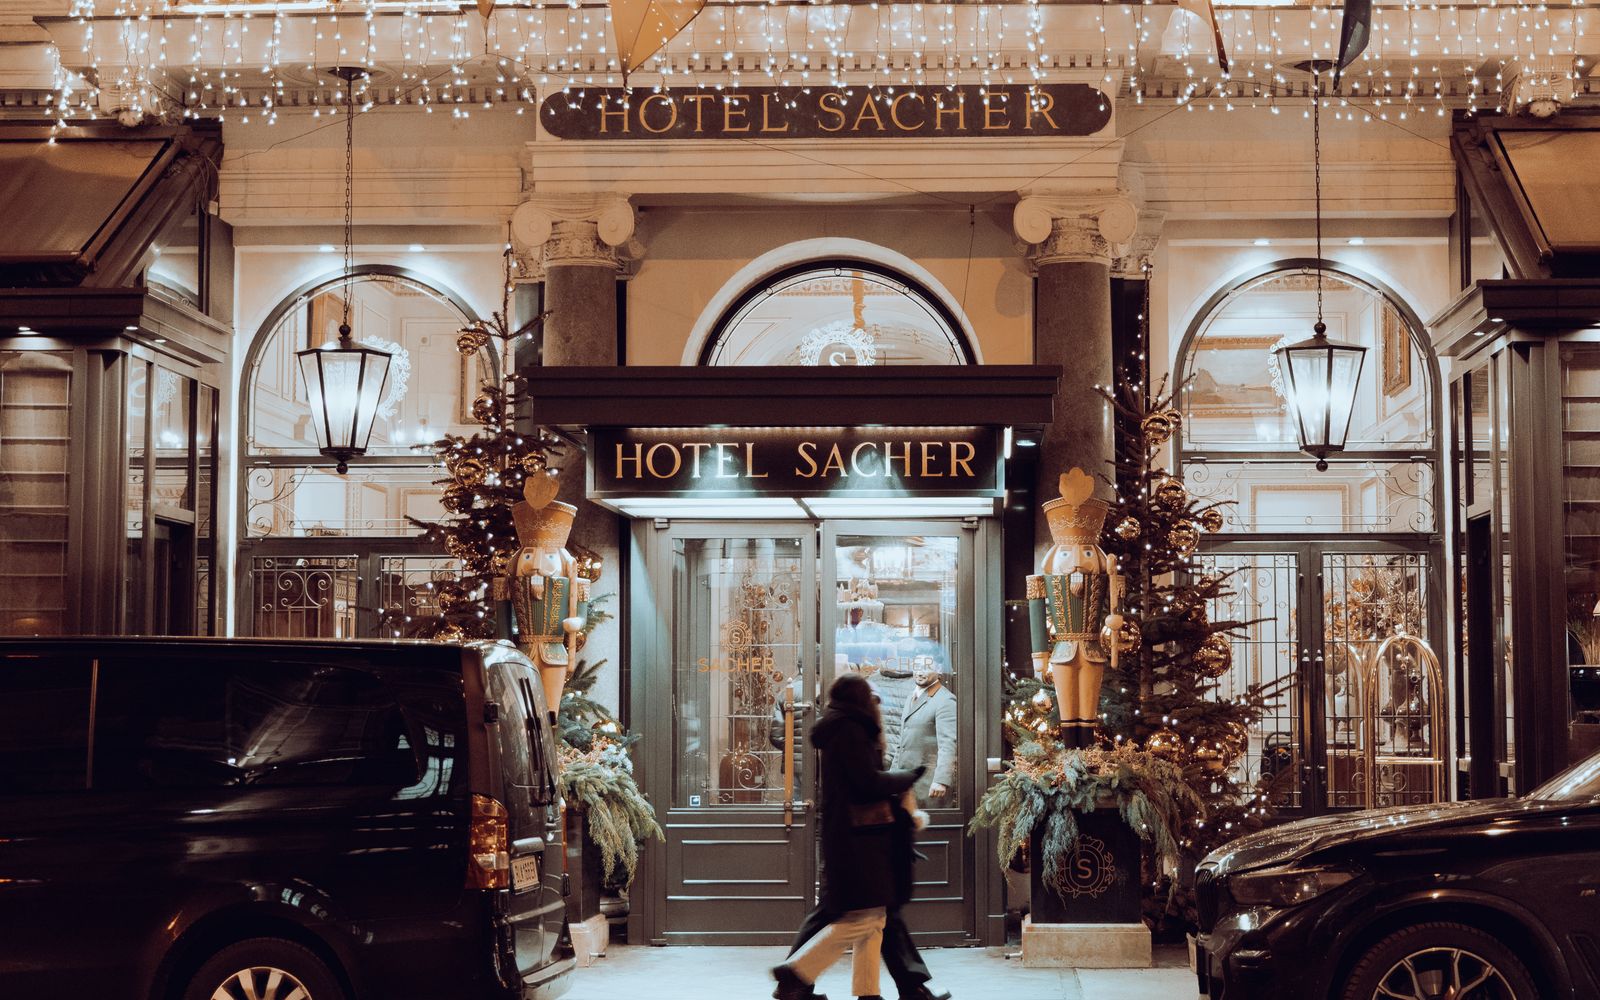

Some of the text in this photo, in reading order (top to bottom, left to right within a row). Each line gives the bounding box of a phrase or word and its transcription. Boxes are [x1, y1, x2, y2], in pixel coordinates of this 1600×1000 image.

[600, 92, 1060, 133] HOTEL SACHER
[615, 442, 976, 479] HOTEL SACHER
[697, 657, 775, 673] SACHER
[1077, 858, 1092, 879] S
